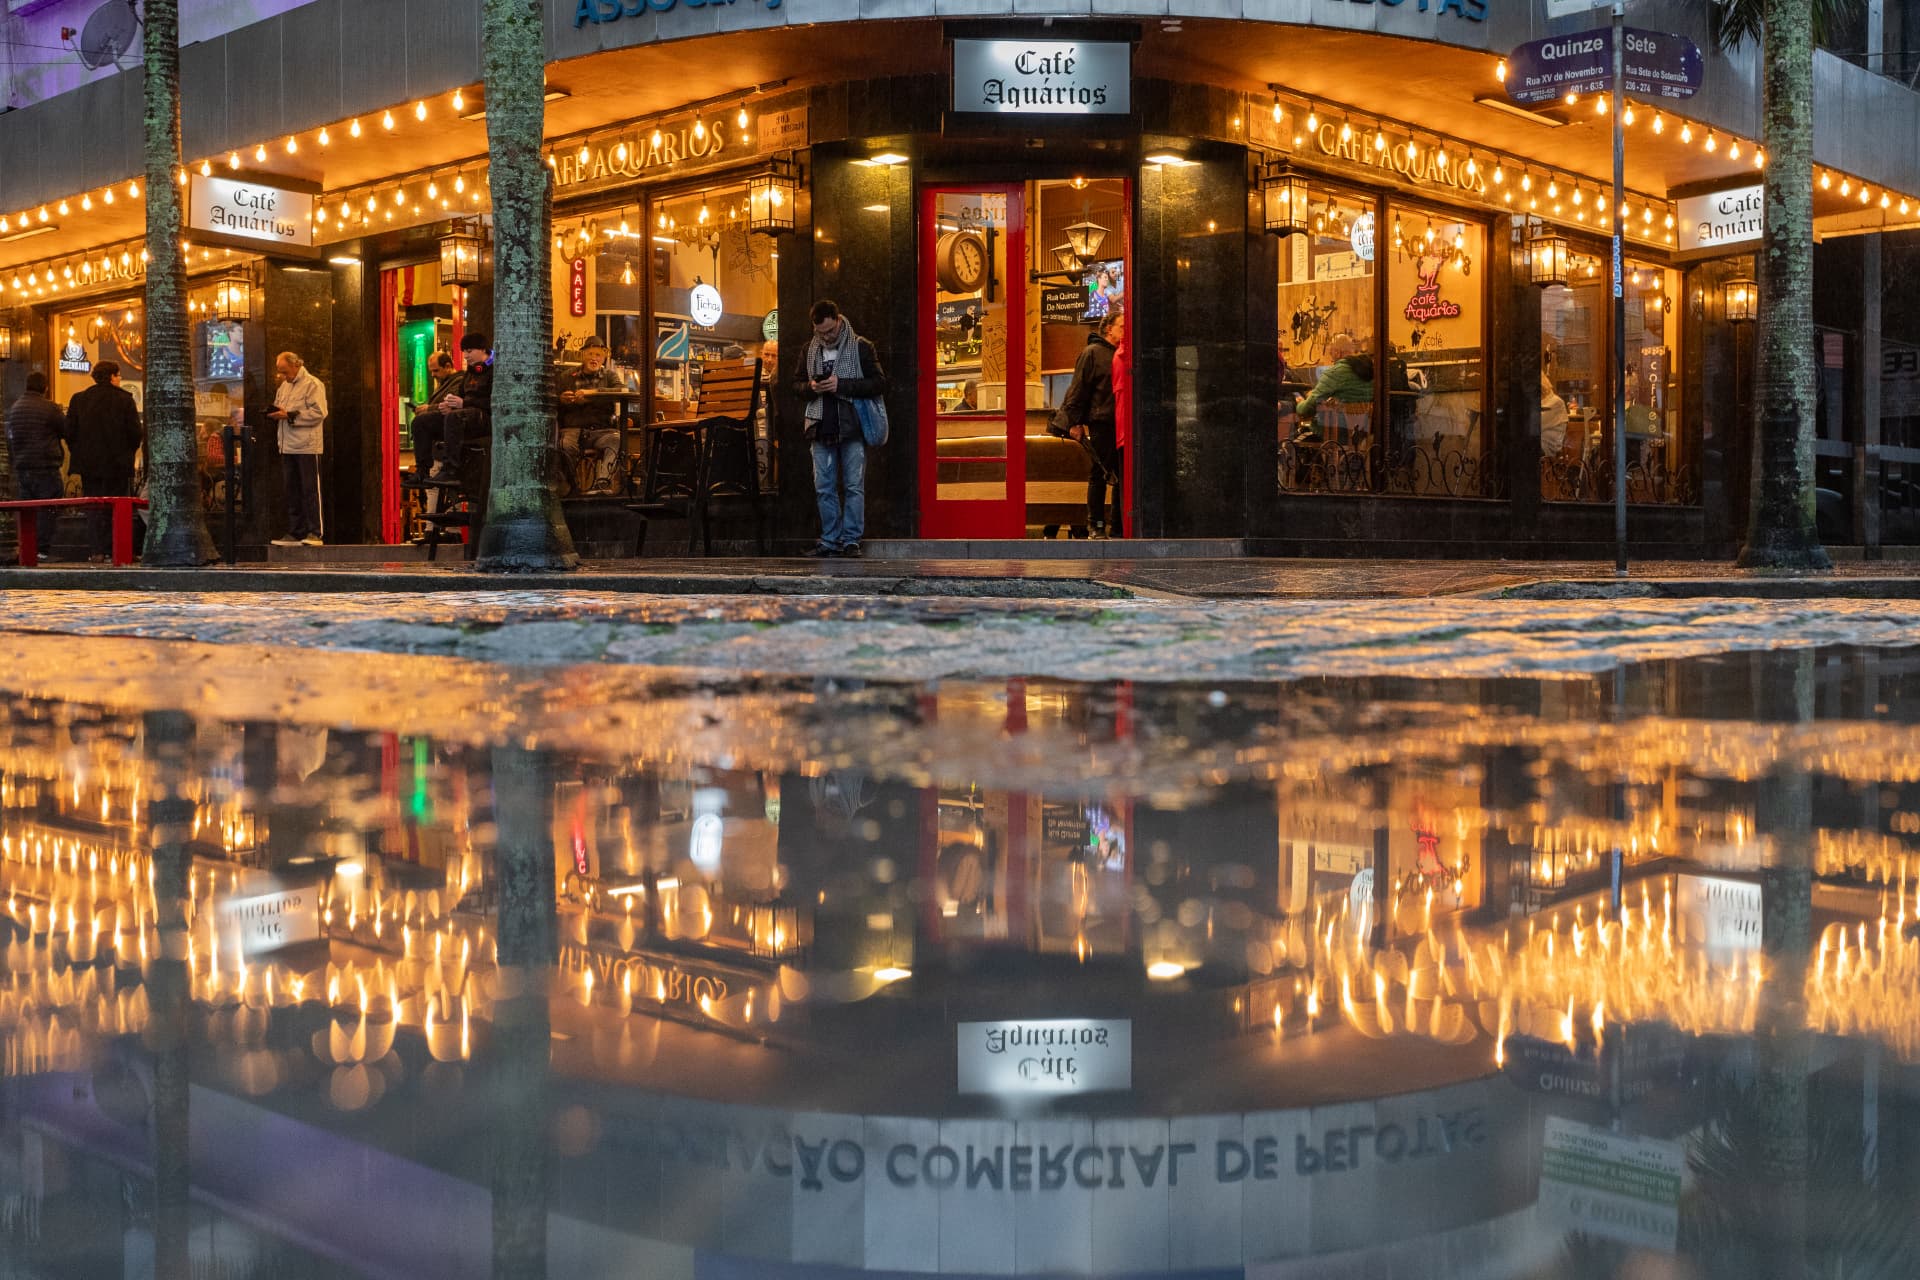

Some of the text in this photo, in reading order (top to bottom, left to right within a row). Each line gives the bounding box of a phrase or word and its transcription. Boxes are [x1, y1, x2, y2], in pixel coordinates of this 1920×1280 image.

[1541, 38, 1604, 60] Quinze
[1626, 34, 1656, 54] Sete
[1015, 48, 1075, 75] Café
[1525, 66, 1604, 87] Rua XV de Novembro
[1625, 64, 1688, 83] Rua Sete de Setembro
[983, 77, 1107, 109] Aquários
[233, 189, 276, 212] Café
[1719, 189, 1762, 215] Café
[209, 205, 296, 237] Aquários
[1697, 213, 1763, 241] Aquári
[573, 259, 583, 314] CAFÉ
[696, 293, 721, 312] Fichas
[1056, 301, 1086, 310] Novembro
[1411, 293, 1437, 305] café
[1405, 301, 1459, 321] Aquários
